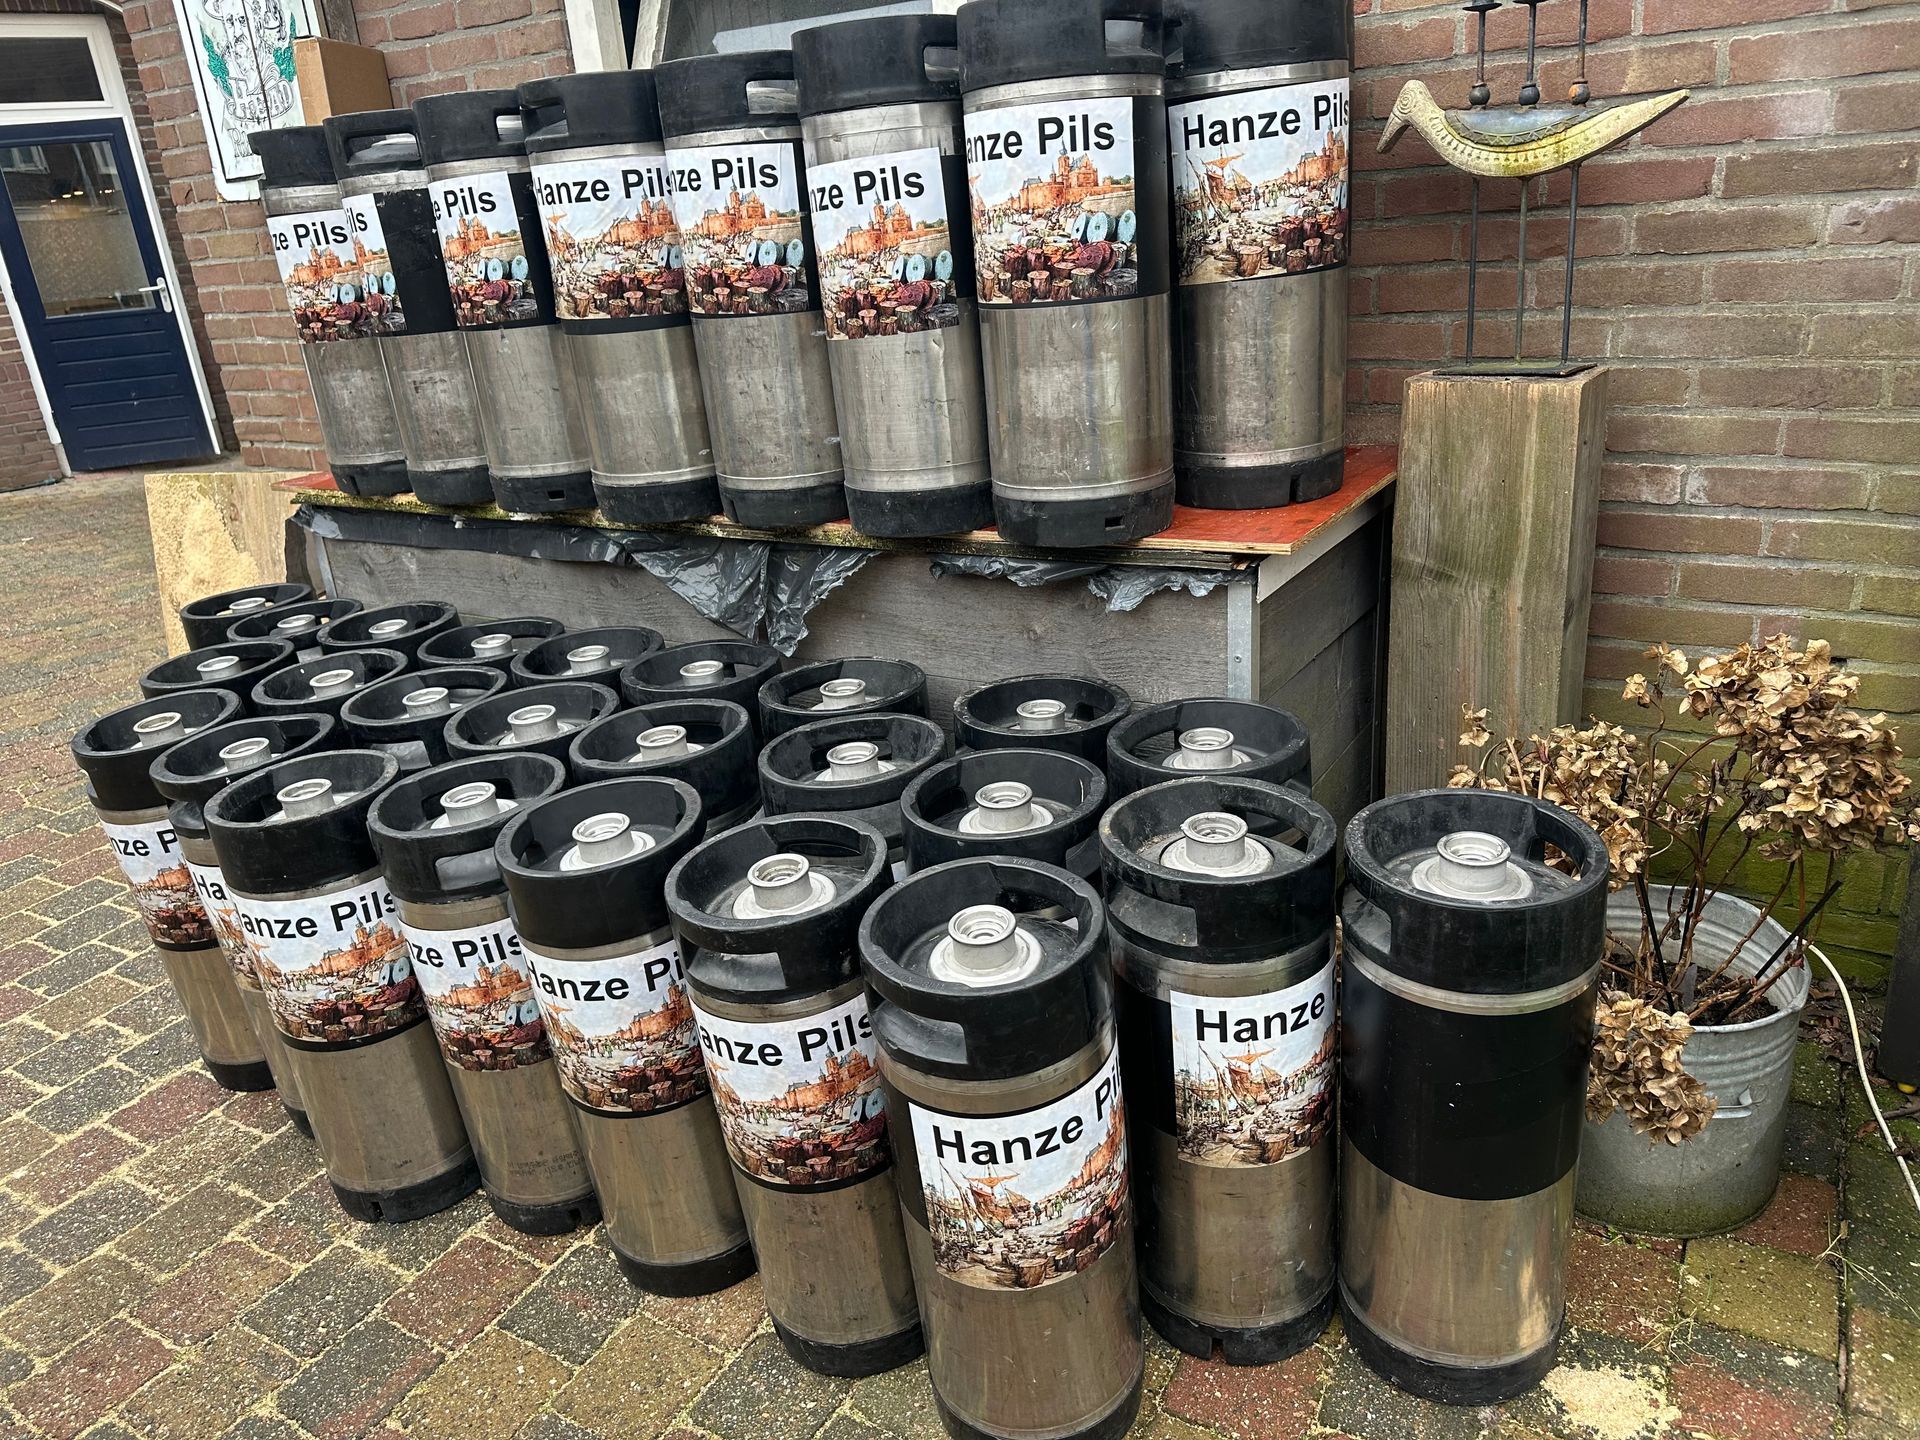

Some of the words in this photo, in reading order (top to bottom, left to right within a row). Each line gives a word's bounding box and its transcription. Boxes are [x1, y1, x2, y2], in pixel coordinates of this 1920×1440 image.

[966, 130, 1023, 164] anze
[1037, 114, 1115, 155] Pils
[1183, 108, 1301, 151] Hanze
[671, 168, 702, 192] nze
[711, 157, 779, 190] Pils
[810, 184, 844, 213] nze
[853, 166, 925, 205] Pils
[346, 207, 368, 232] ils
[443, 187, 497, 218] Pils
[293, 221, 349, 248] Pils
[110, 836, 150, 856] nze
[241, 904, 318, 939] anze
[643, 951, 684, 992] Pi
[1195, 991, 1326, 1043] Hanze
[700, 1025, 783, 1067] anze
[932, 1113, 1083, 1166] Hanze
[1095, 1054, 1120, 1122] Pil
